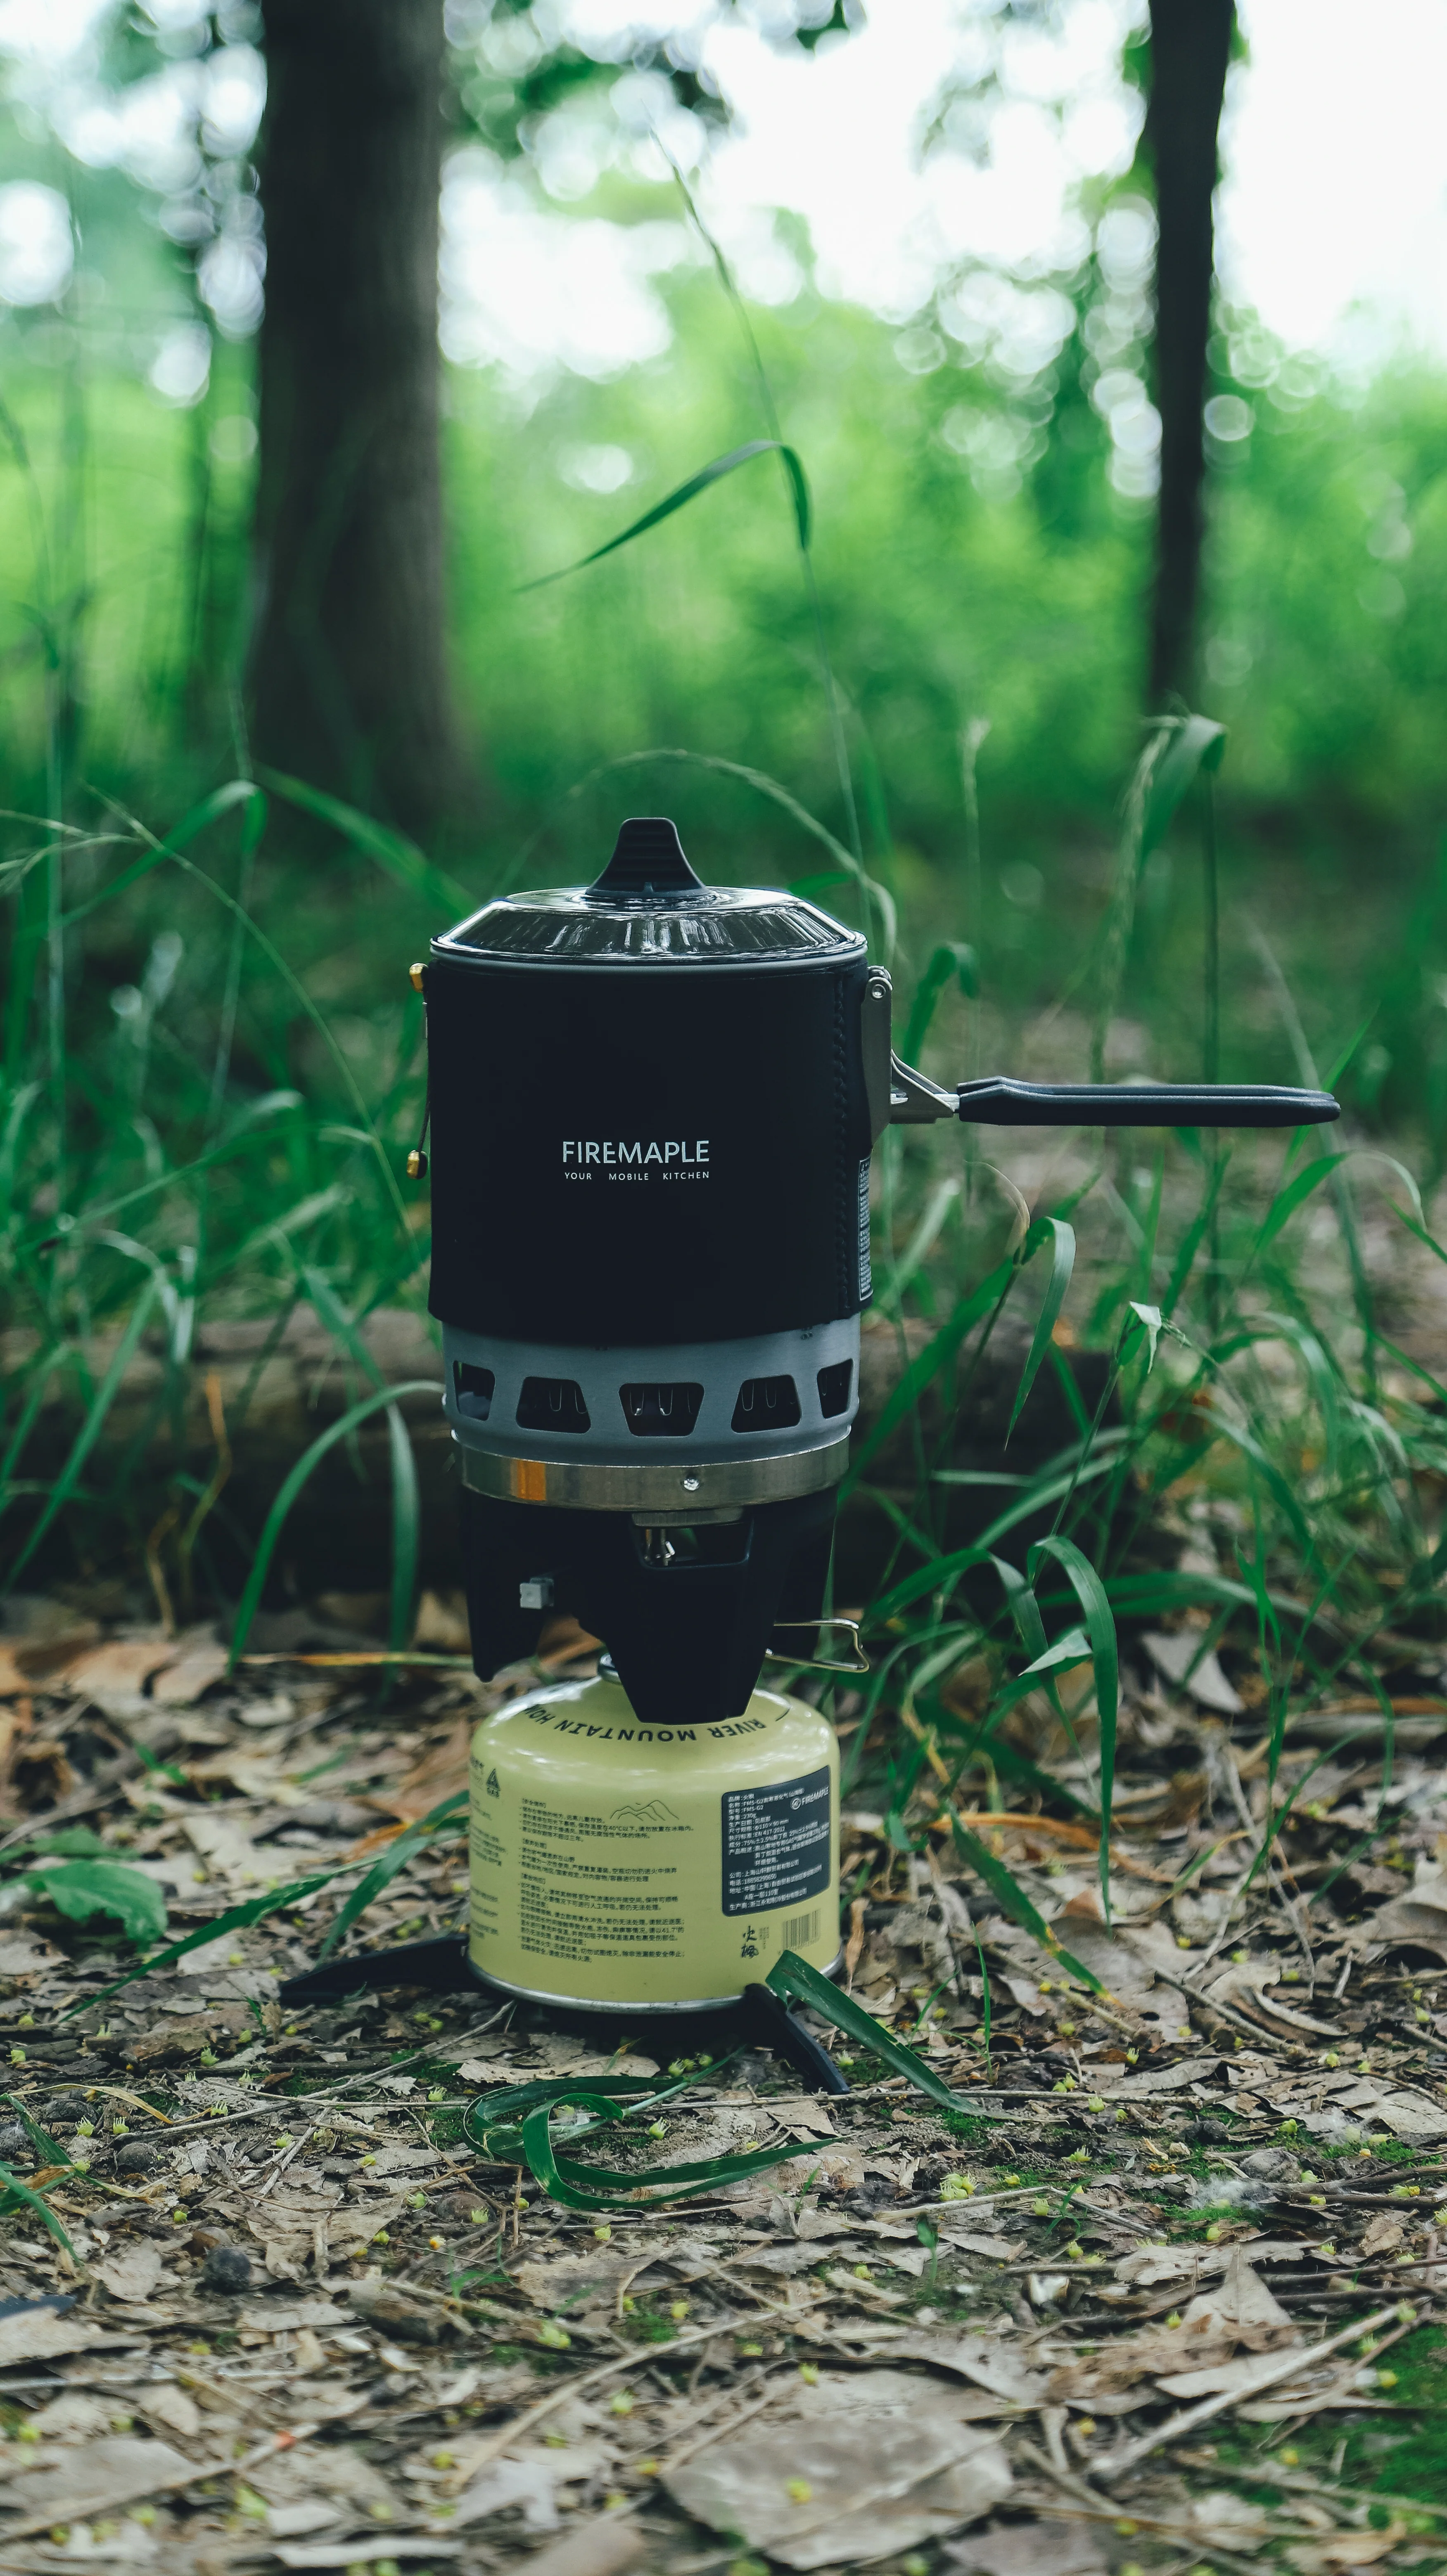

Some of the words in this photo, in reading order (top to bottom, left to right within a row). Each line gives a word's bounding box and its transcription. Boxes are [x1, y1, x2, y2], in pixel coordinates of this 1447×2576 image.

[563, 1140, 709, 1164] FIREMAPLE
[565, 1172, 592, 1180] YOUR
[662, 1171, 709, 1180] KITCHEN
[553, 1720, 697, 1742] MOUNTAIN
[707, 1719, 767, 1738] RIVER
